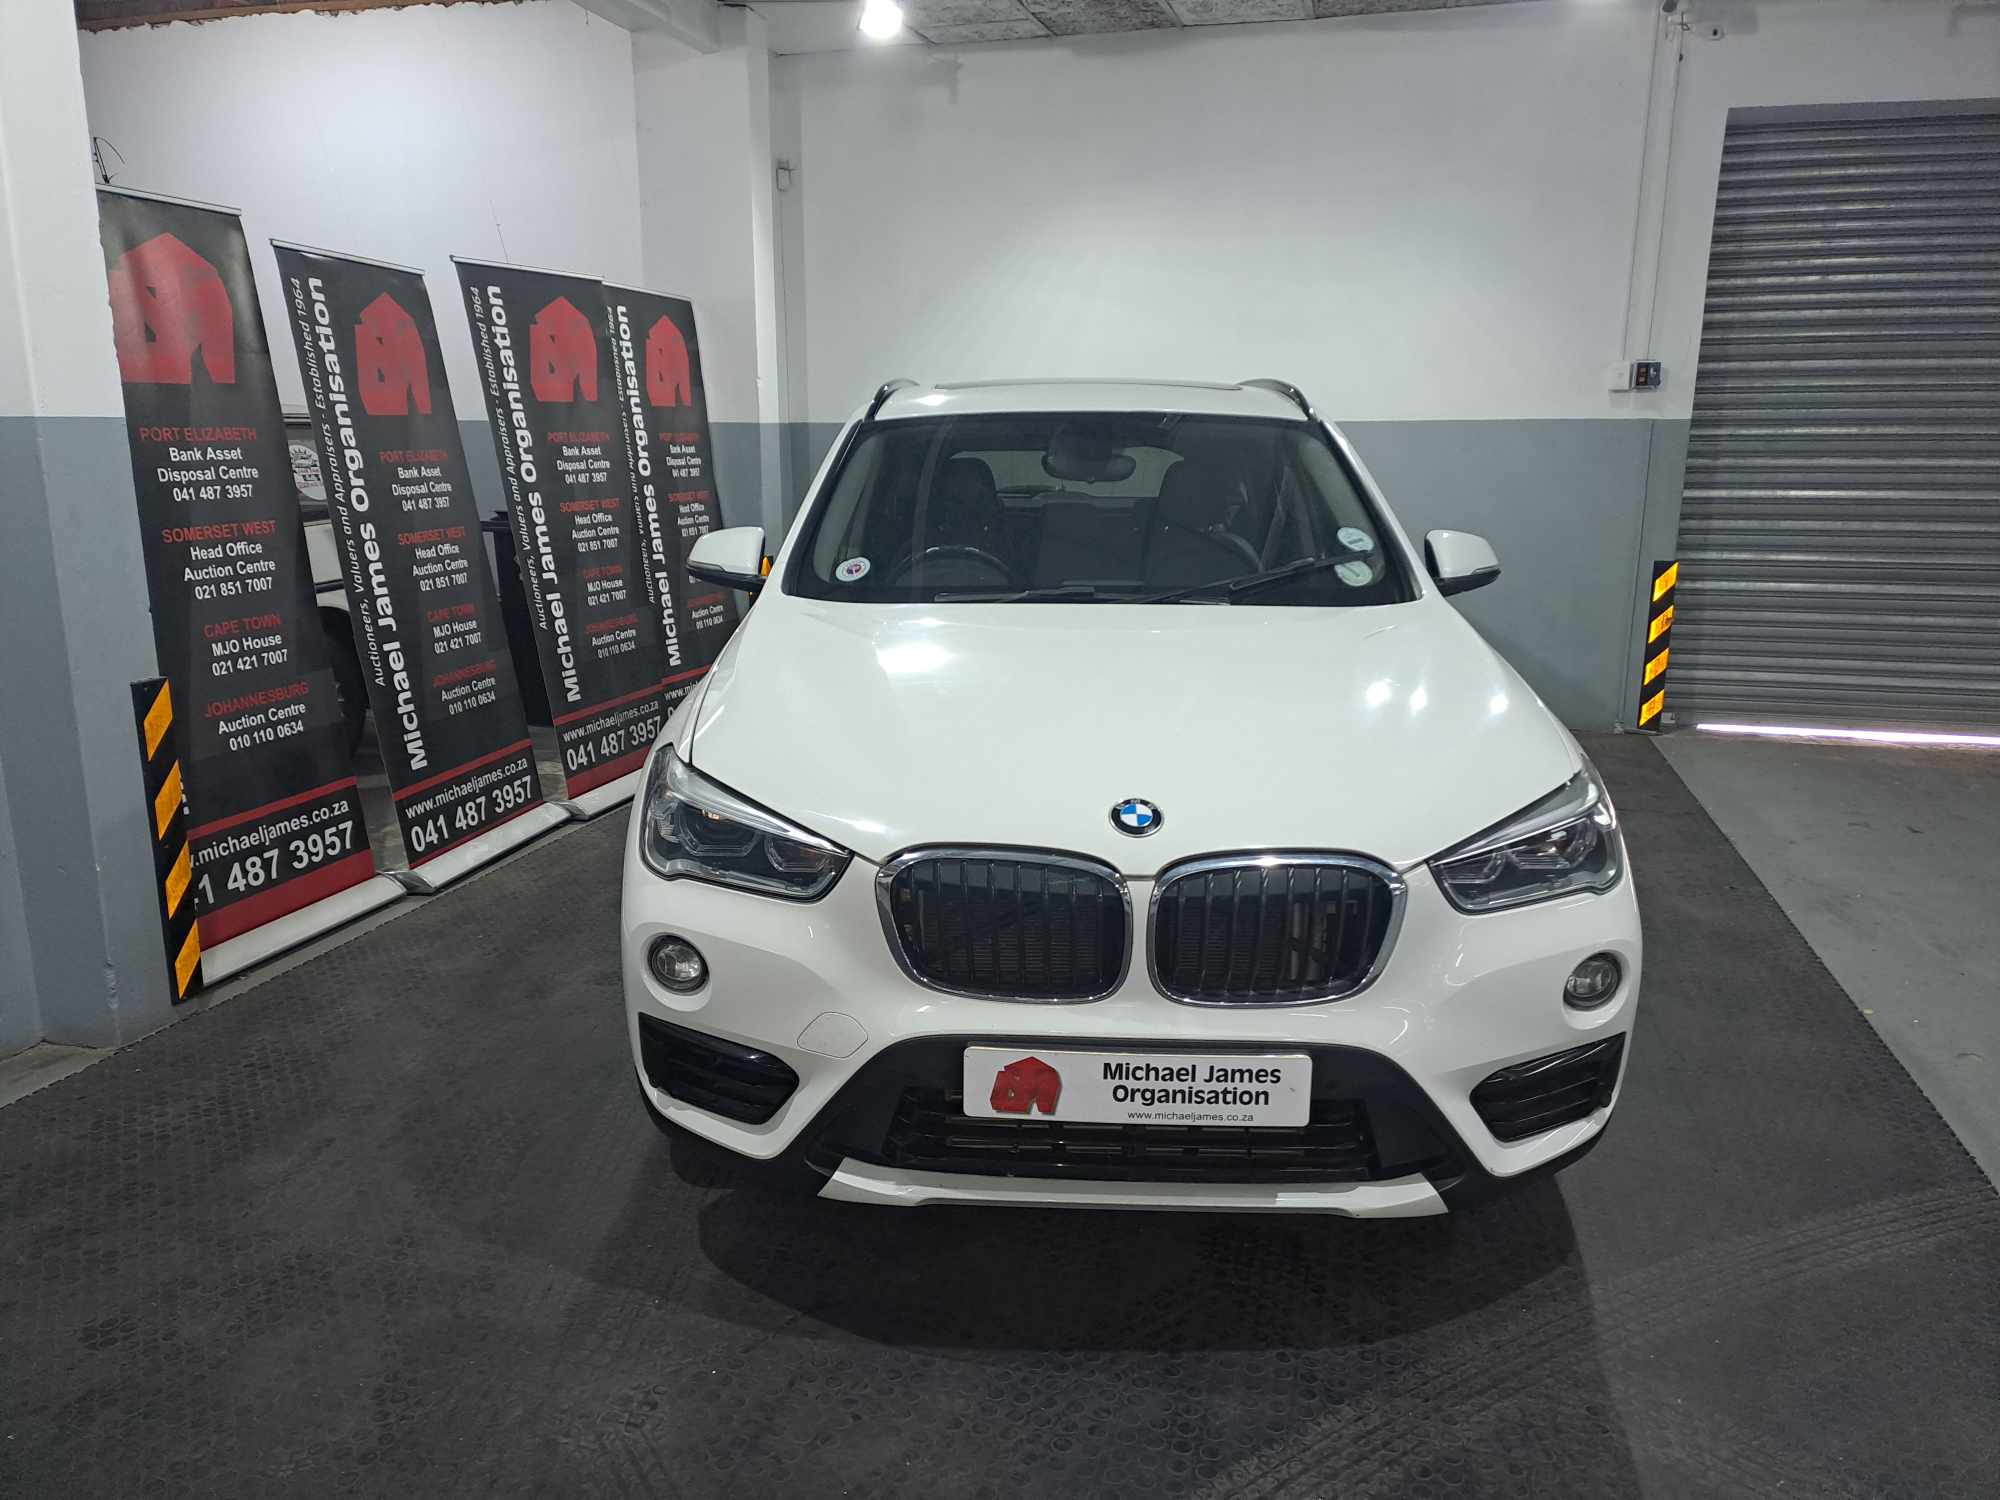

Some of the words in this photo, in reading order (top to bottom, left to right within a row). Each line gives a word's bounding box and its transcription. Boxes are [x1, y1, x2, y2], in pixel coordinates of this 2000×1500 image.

[290, 277, 307, 316] 1964
[470, 286, 484, 319] 1964
[299, 320, 327, 410] Established
[476, 322, 499, 397] Established
[308, 277, 369, 513] Organisation
[487, 285, 537, 483] Organisation
[617, 305, 651, 477] Organisation
[140, 428, 182, 442] PORT
[185, 426, 257, 440] ELIZABETH
[495, 406, 516, 475] Appraisers
[169, 446, 203, 462] Bank
[207, 447, 242, 461] Asset
[321, 422, 346, 504] Appraisers
[562, 446, 580, 456] Bank
[581, 446, 601, 456] Asset
[157, 467, 215, 484] Disposal
[219, 465, 259, 481] Centre
[398, 467, 419, 479] Bank
[421, 466, 441, 477] Asset
[557, 460, 587, 471] Disposal
[173, 487, 197, 502] 041
[199, 485, 225, 501] 487
[227, 484, 253, 499] 3957
[392, 484, 428, 497] Disposal
[429, 481, 452, 493] Centre
[508, 477, 521, 502] and
[402, 500, 417, 512] 041
[418, 498, 432, 510] 487
[161, 523, 239, 543] SOMERSET
[241, 519, 276, 537] WEST
[337, 506, 353, 535] and
[513, 505, 531, 550] Valuers
[575, 514, 591, 525] Head
[592, 512, 612, 523] Office
[643, 484, 665, 565] James
[528, 492, 558, 584] James
[572, 528, 596, 540] Auction
[190, 544, 223, 561] Head
[226, 541, 263, 557] Office
[415, 547, 437, 560] Head
[438, 544, 460, 555] Office
[183, 563, 233, 582] Auction
[236, 558, 276, 575] Centre
[343, 539, 364, 593] Valuers
[360, 522, 397, 632] James
[412, 563, 444, 577] Auction
[445, 558, 469, 571] Centre
[194, 584, 217, 600] 021
[220, 581, 242, 597] 851
[248, 576, 273, 593] 7007
[420, 579, 434, 592] 021
[436, 577, 450, 589] 851
[526, 553, 548, 630] Auctioneers,
[601, 579, 623, 589] House
[204, 620, 240, 638] CAPE
[242, 613, 281, 632] TOWN
[433, 625, 451, 638] MJO
[453, 619, 477, 633] House
[654, 571, 681, 667] Michael
[211, 639, 240, 657] MJO
[242, 633, 282, 651] House
[360, 599, 387, 687] Auctioneers,
[434, 641, 449, 654] 021
[465, 632, 481, 646] 7007
[546, 592, 582, 702] Michael
[211, 658, 234, 677] 021
[236, 654, 258, 672] 421
[261, 649, 288, 667] 7007
[205, 681, 310, 718] JOHANNESBURG
[441, 685, 471, 701] Auction
[472, 677, 496, 692] Centre
[218, 711, 266, 735] Auction
[268, 701, 306, 721] Centre
[382, 641, 428, 771] Michael
[449, 702, 463, 715] 010
[464, 697, 478, 711] 110
[563, 700, 659, 743] www.michaeljames.co.za
[229, 733, 251, 751] 010
[253, 726, 274, 745] 110
[276, 719, 304, 738] 0634
[566, 741, 596, 771] 041
[601, 730, 625, 757] 487
[629, 716, 661, 745] 3957
[405, 758, 528, 819] www.michaeljames.co.za
[410, 814, 449, 852] 041
[455, 796, 486, 831] 487
[492, 775, 531, 814] 3957
[227, 848, 280, 893] 487
[289, 820, 353, 869] 3957
[1103, 1062, 1197, 1083] Michael
[1203, 1065, 1281, 1084] James
[1112, 1084, 1269, 1107] Organisation
[1127, 1111, 1254, 1122] www.michaeljames.co.za
